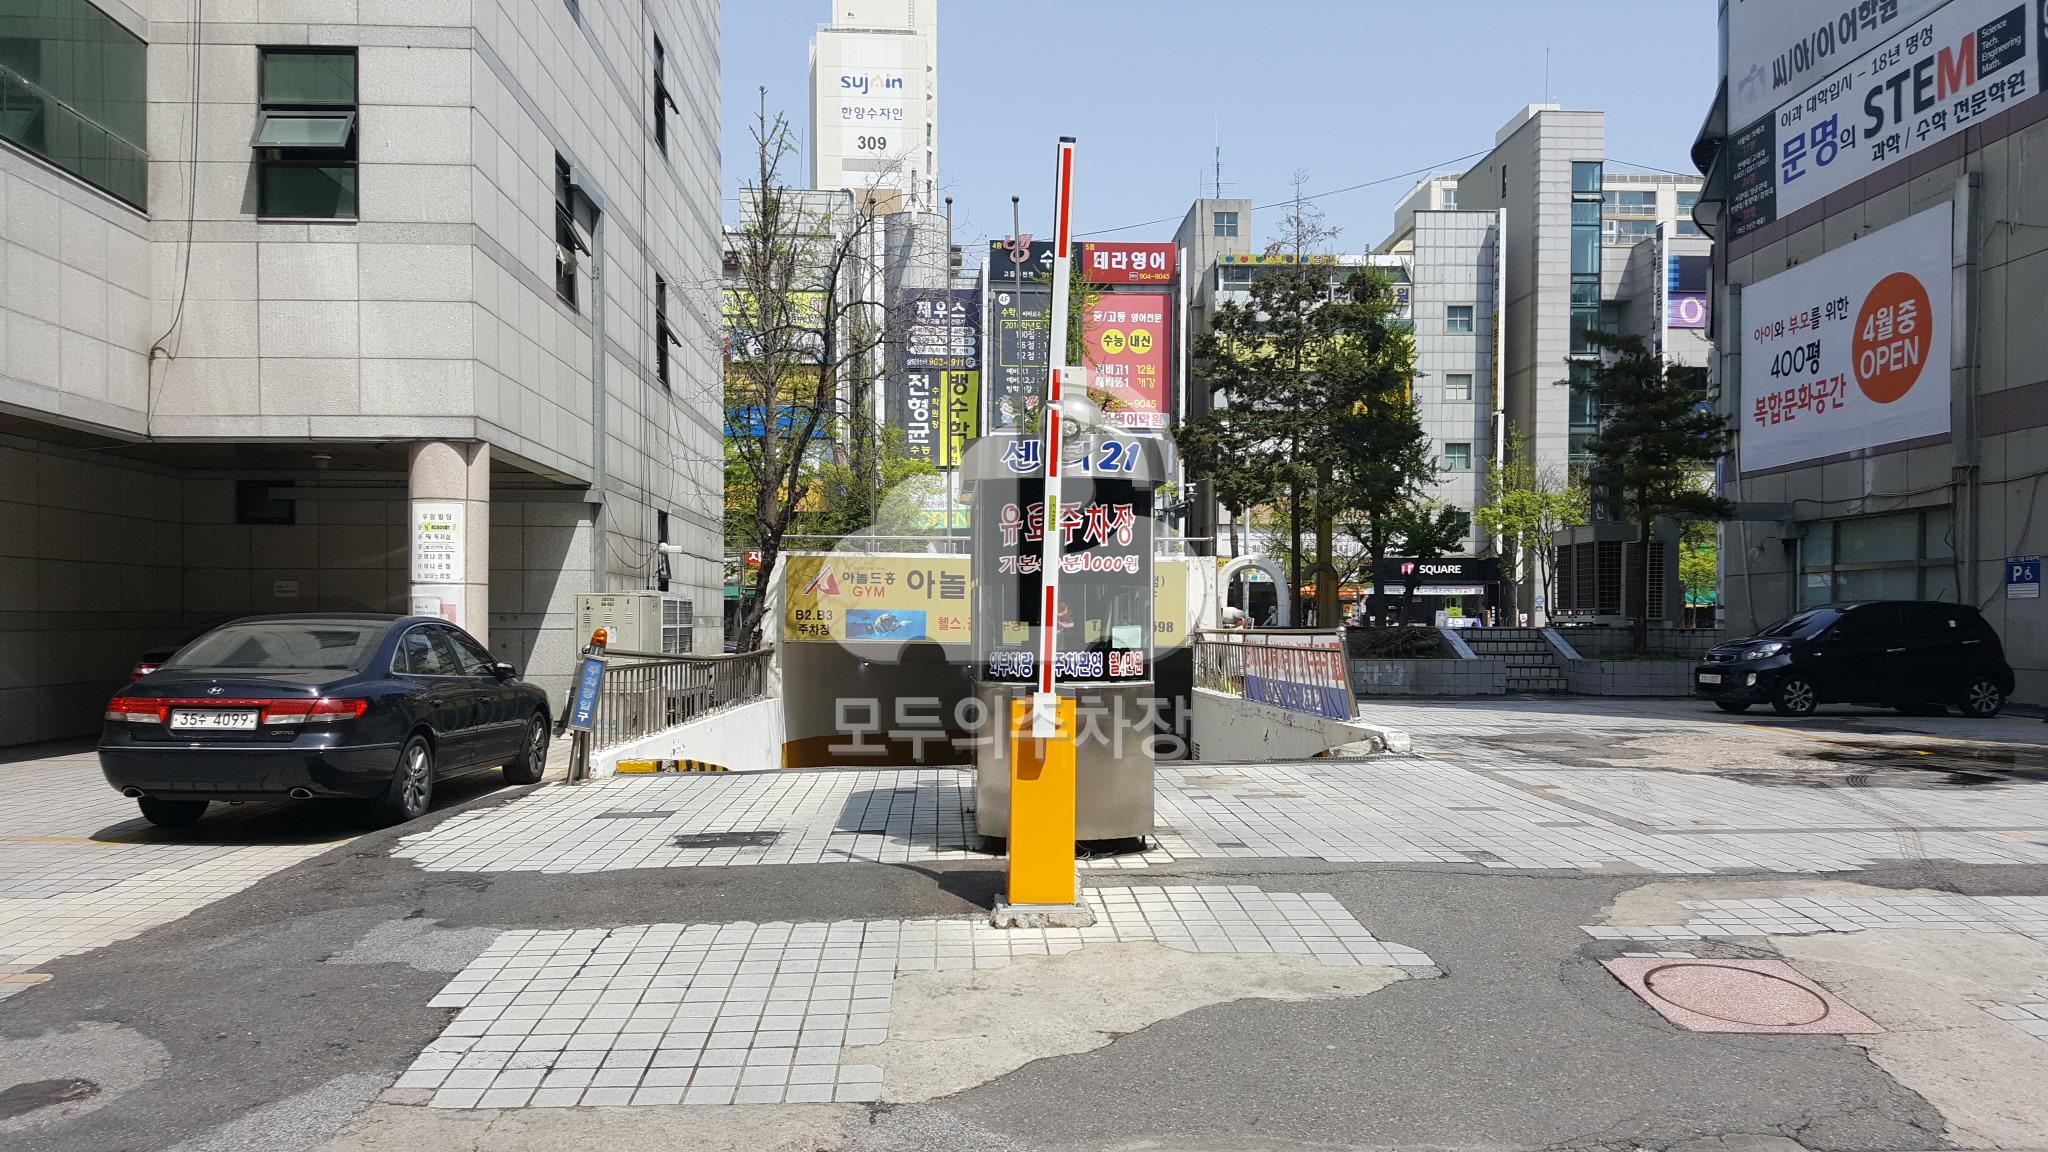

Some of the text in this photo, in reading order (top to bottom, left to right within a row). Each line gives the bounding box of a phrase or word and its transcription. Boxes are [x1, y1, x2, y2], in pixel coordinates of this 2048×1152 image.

[1981, 20, 2007, 38] Science
[1981, 36, 2000, 50] Tech.
[1981, 35, 2022, 62] Engineering
[1982, 58, 2002, 74] Math.
[1781, 103, 1802, 127] 이과
[1806, 73, 1852, 113] 대학입시
[1871, 43, 1900, 76] 18년
[1906, 24, 1933, 55] 명성
[1863, 31, 1976, 139] STEM
[841, 106, 903, 120] 한양수자인
[1872, 133, 1900, 161] 과학
[1916, 109, 1948, 142] 수학
[1953, 69, 2026, 124] 전문학원
[857, 135, 887, 150] 309
[1782, 113, 1856, 185] 문명의
[1093, 251, 1166, 270] 테라영어
[916, 301, 966, 318] 제우스
[1130, 312, 1163, 324] 영어전문
[1754, 296, 1849, 345] 아이와 부모를 위한
[1862, 299, 1917, 342] 4월 중
[1102, 334, 1125, 348] 수능
[1130, 334, 1152, 348] 내신
[1770, 339, 1821, 379] 400평
[1860, 336, 1919, 380] OPEN
[1136, 377, 1155, 389] 개강
[1753, 373, 1847, 427] 복합문화공간
[999, 501, 1136, 547] 유료주차장
[1419, 565, 1461, 575] SQUARE
[2013, 565, 2022, 581] P
[852, 585, 885, 598] GYM
[795, 609, 833, 621] B2.B3
[797, 623, 831, 636] 주차장
[989, 651, 1034, 677] 외부차량
[180, 713, 249, 726] 35수 4099
